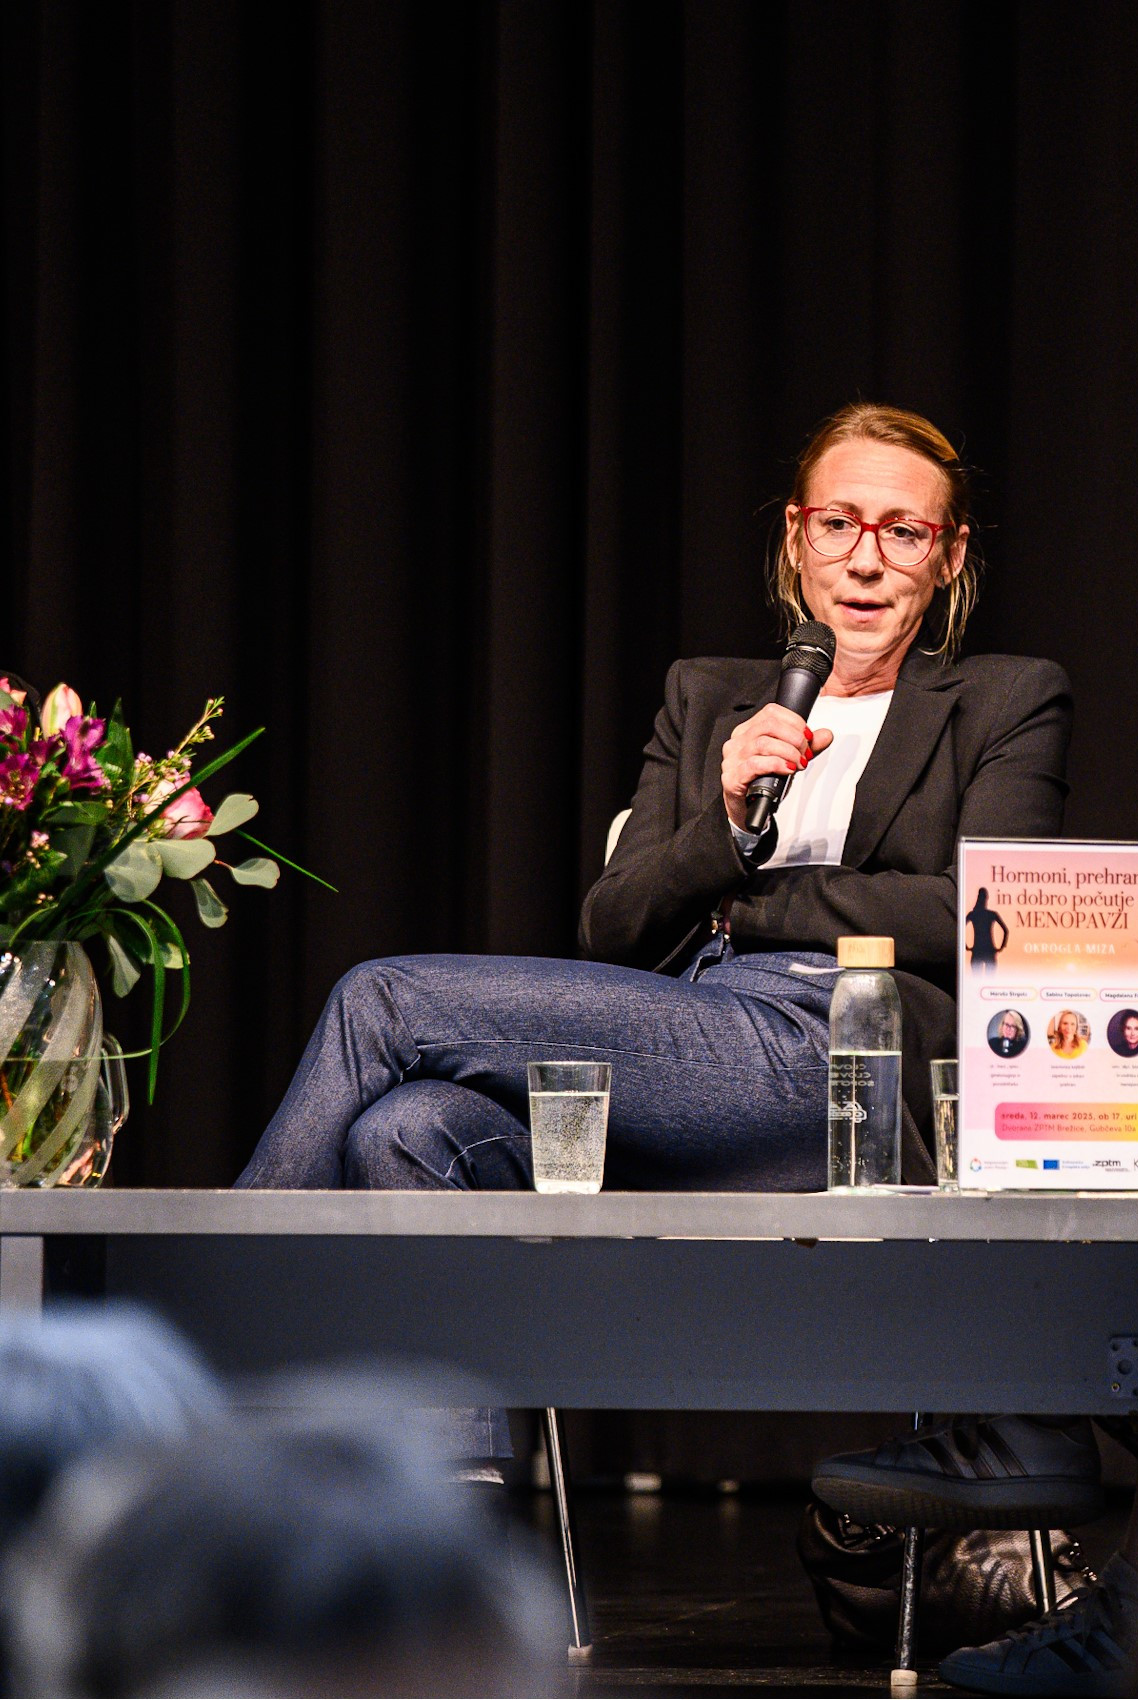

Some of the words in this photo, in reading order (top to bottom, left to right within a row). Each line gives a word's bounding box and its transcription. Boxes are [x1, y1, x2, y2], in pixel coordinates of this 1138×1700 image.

[991, 865, 1071, 886] Hormoni,
[997, 890, 1012, 905] in
[1017, 889, 1068, 906] dobro
[1073, 891, 1134, 912] počutje
[1016, 911, 1128, 930] MENOPAVZI
[1024, 943, 1081, 954] OKROGLA
[1086, 943, 1116, 955] MIZA
[1002, 1112, 1027, 1120] sreda,
[1072, 1112, 1095, 1121] 2025,
[1112, 1112, 1123, 1120] 17.
[1126, 1112, 1137, 1120] uri
